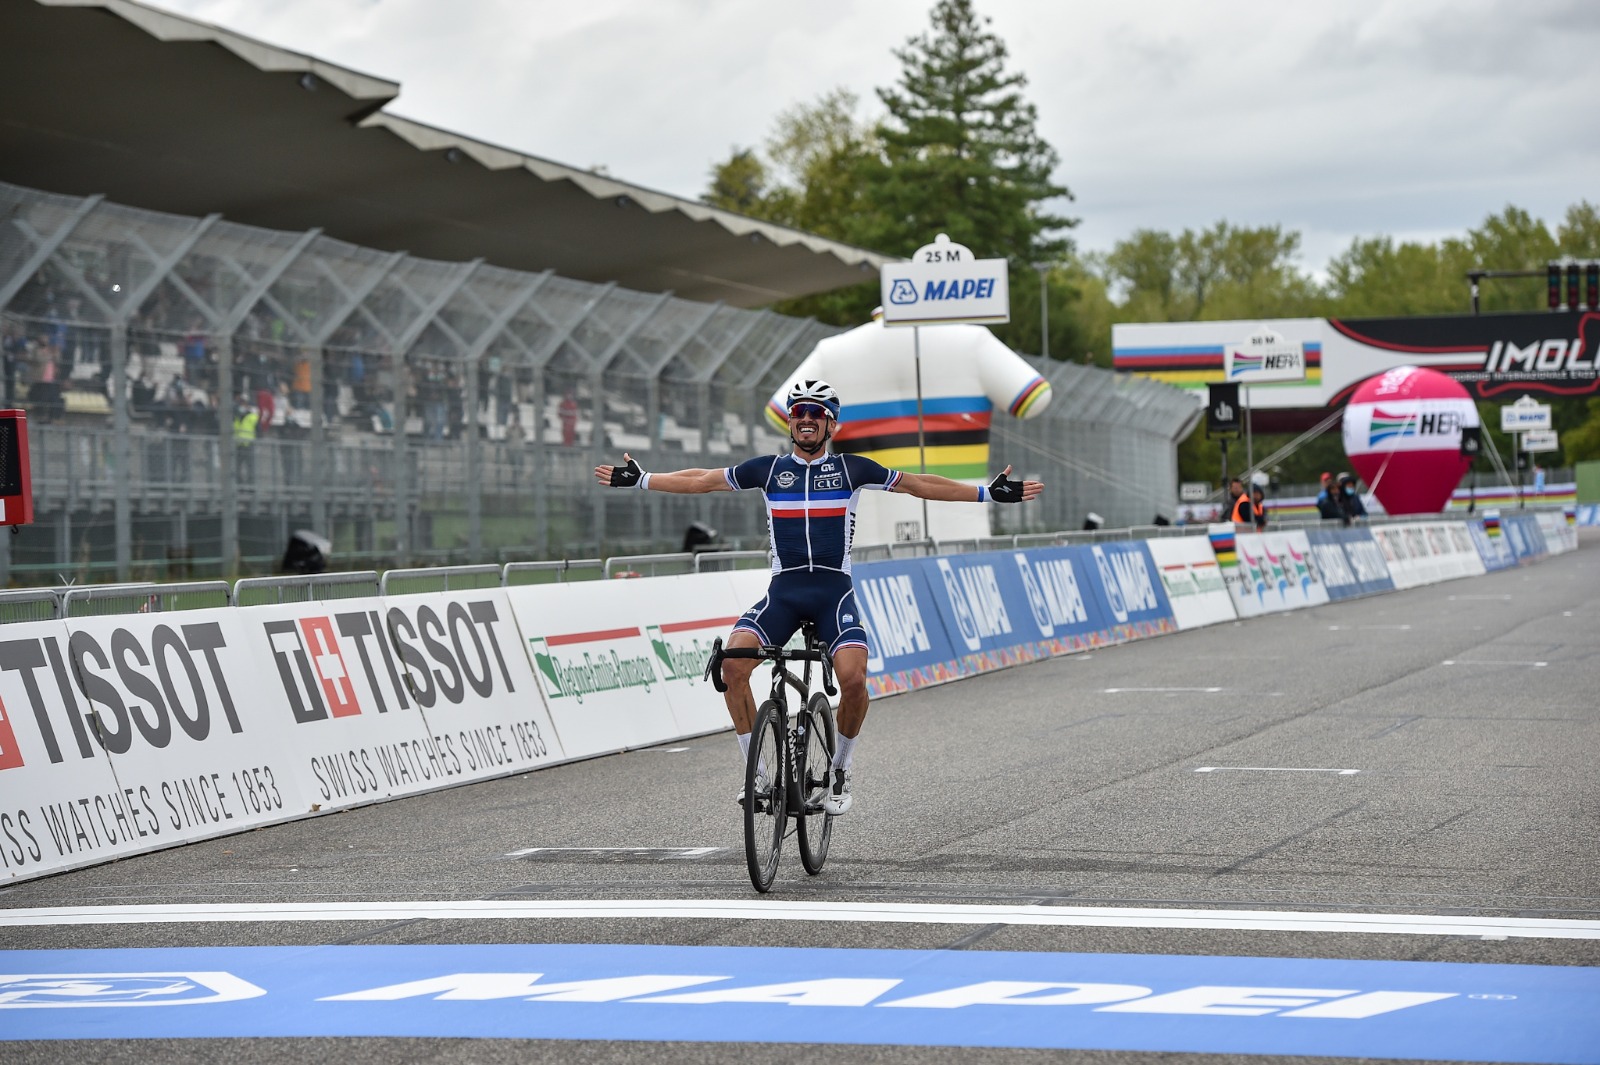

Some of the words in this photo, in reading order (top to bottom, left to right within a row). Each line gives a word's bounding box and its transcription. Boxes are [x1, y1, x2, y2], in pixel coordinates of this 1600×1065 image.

[923, 278, 995, 301] MAPEI
[925, 251, 941, 262] 25
[946, 250, 960, 262] M
[334, 600, 516, 713] TISSOT
[860, 574, 932, 659] MAPEI
[0, 623, 243, 764] TISSOT
[310, 748, 378, 801] SWISS
[374, 734, 461, 788] WATCHES
[459, 725, 513, 772] SINCE
[510, 720, 548, 769] 1853
[0, 808, 43, 869] ISS
[40, 785, 160, 856] WATCHES
[161, 773, 233, 831] SINCE
[231, 765, 283, 816] 1853
[311, 971, 1461, 1019] MAPEI
